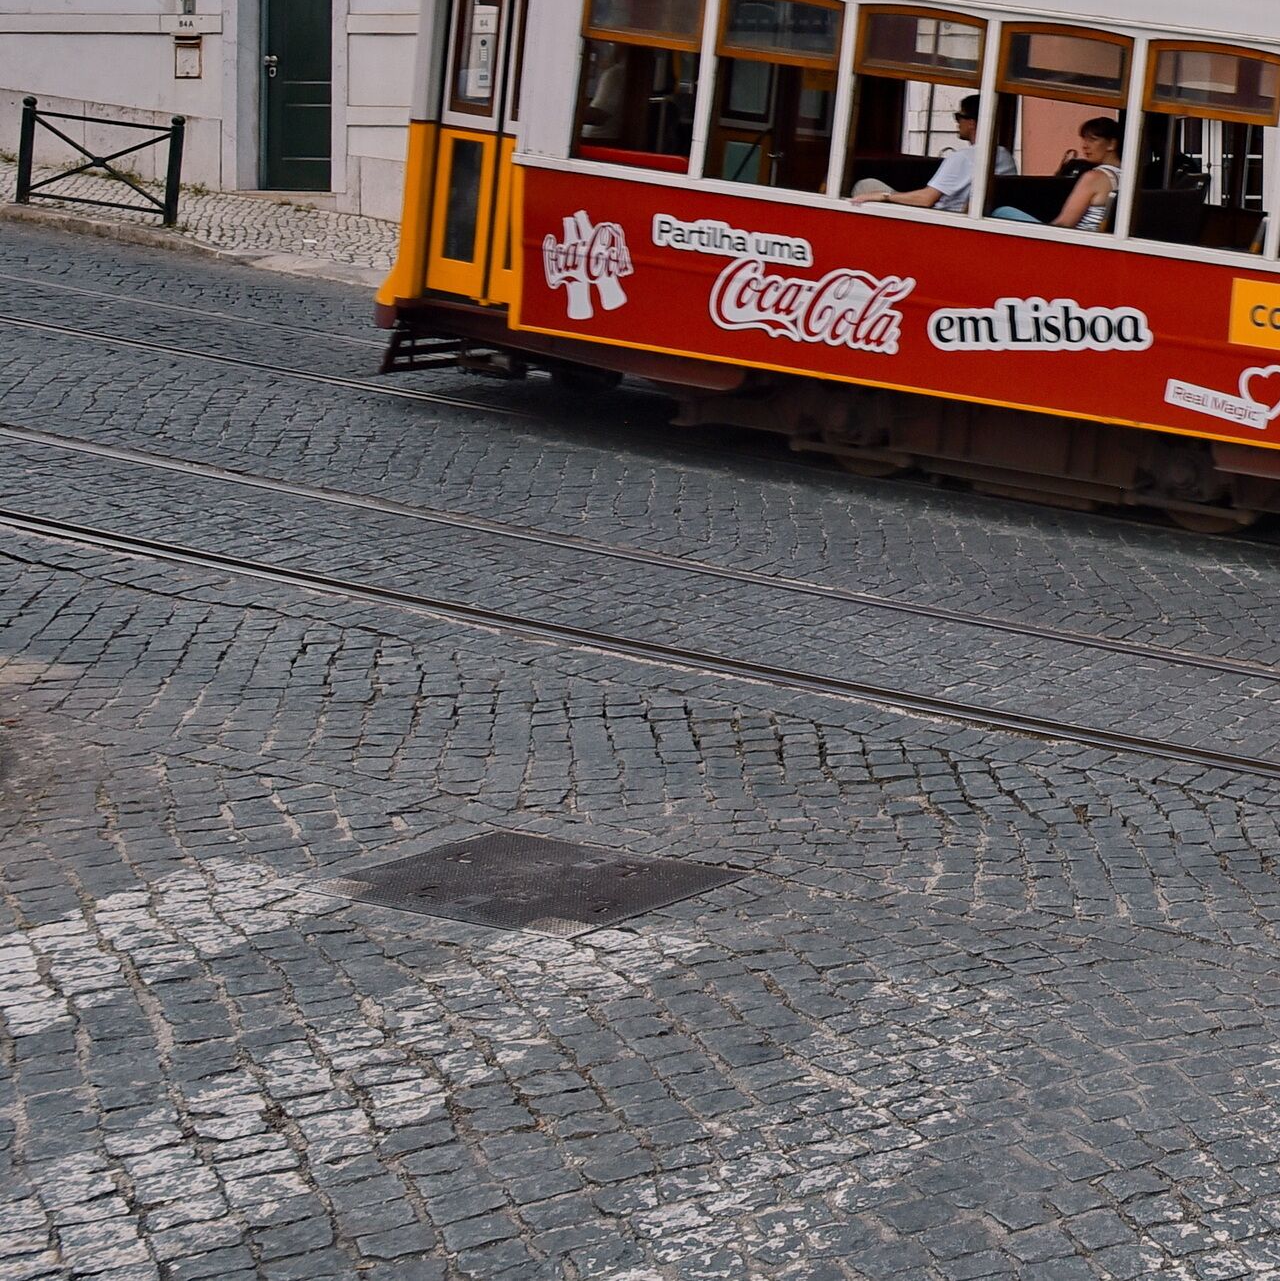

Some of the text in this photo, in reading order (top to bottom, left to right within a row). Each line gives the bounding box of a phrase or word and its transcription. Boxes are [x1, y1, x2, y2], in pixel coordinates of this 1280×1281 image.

[657, 220, 809, 262] Partilha uma
[715, 258, 910, 347] Coca-Cola
[935, 304, 1144, 344] em Lisboa
[1173, 386, 1259, 421] Real Magic
